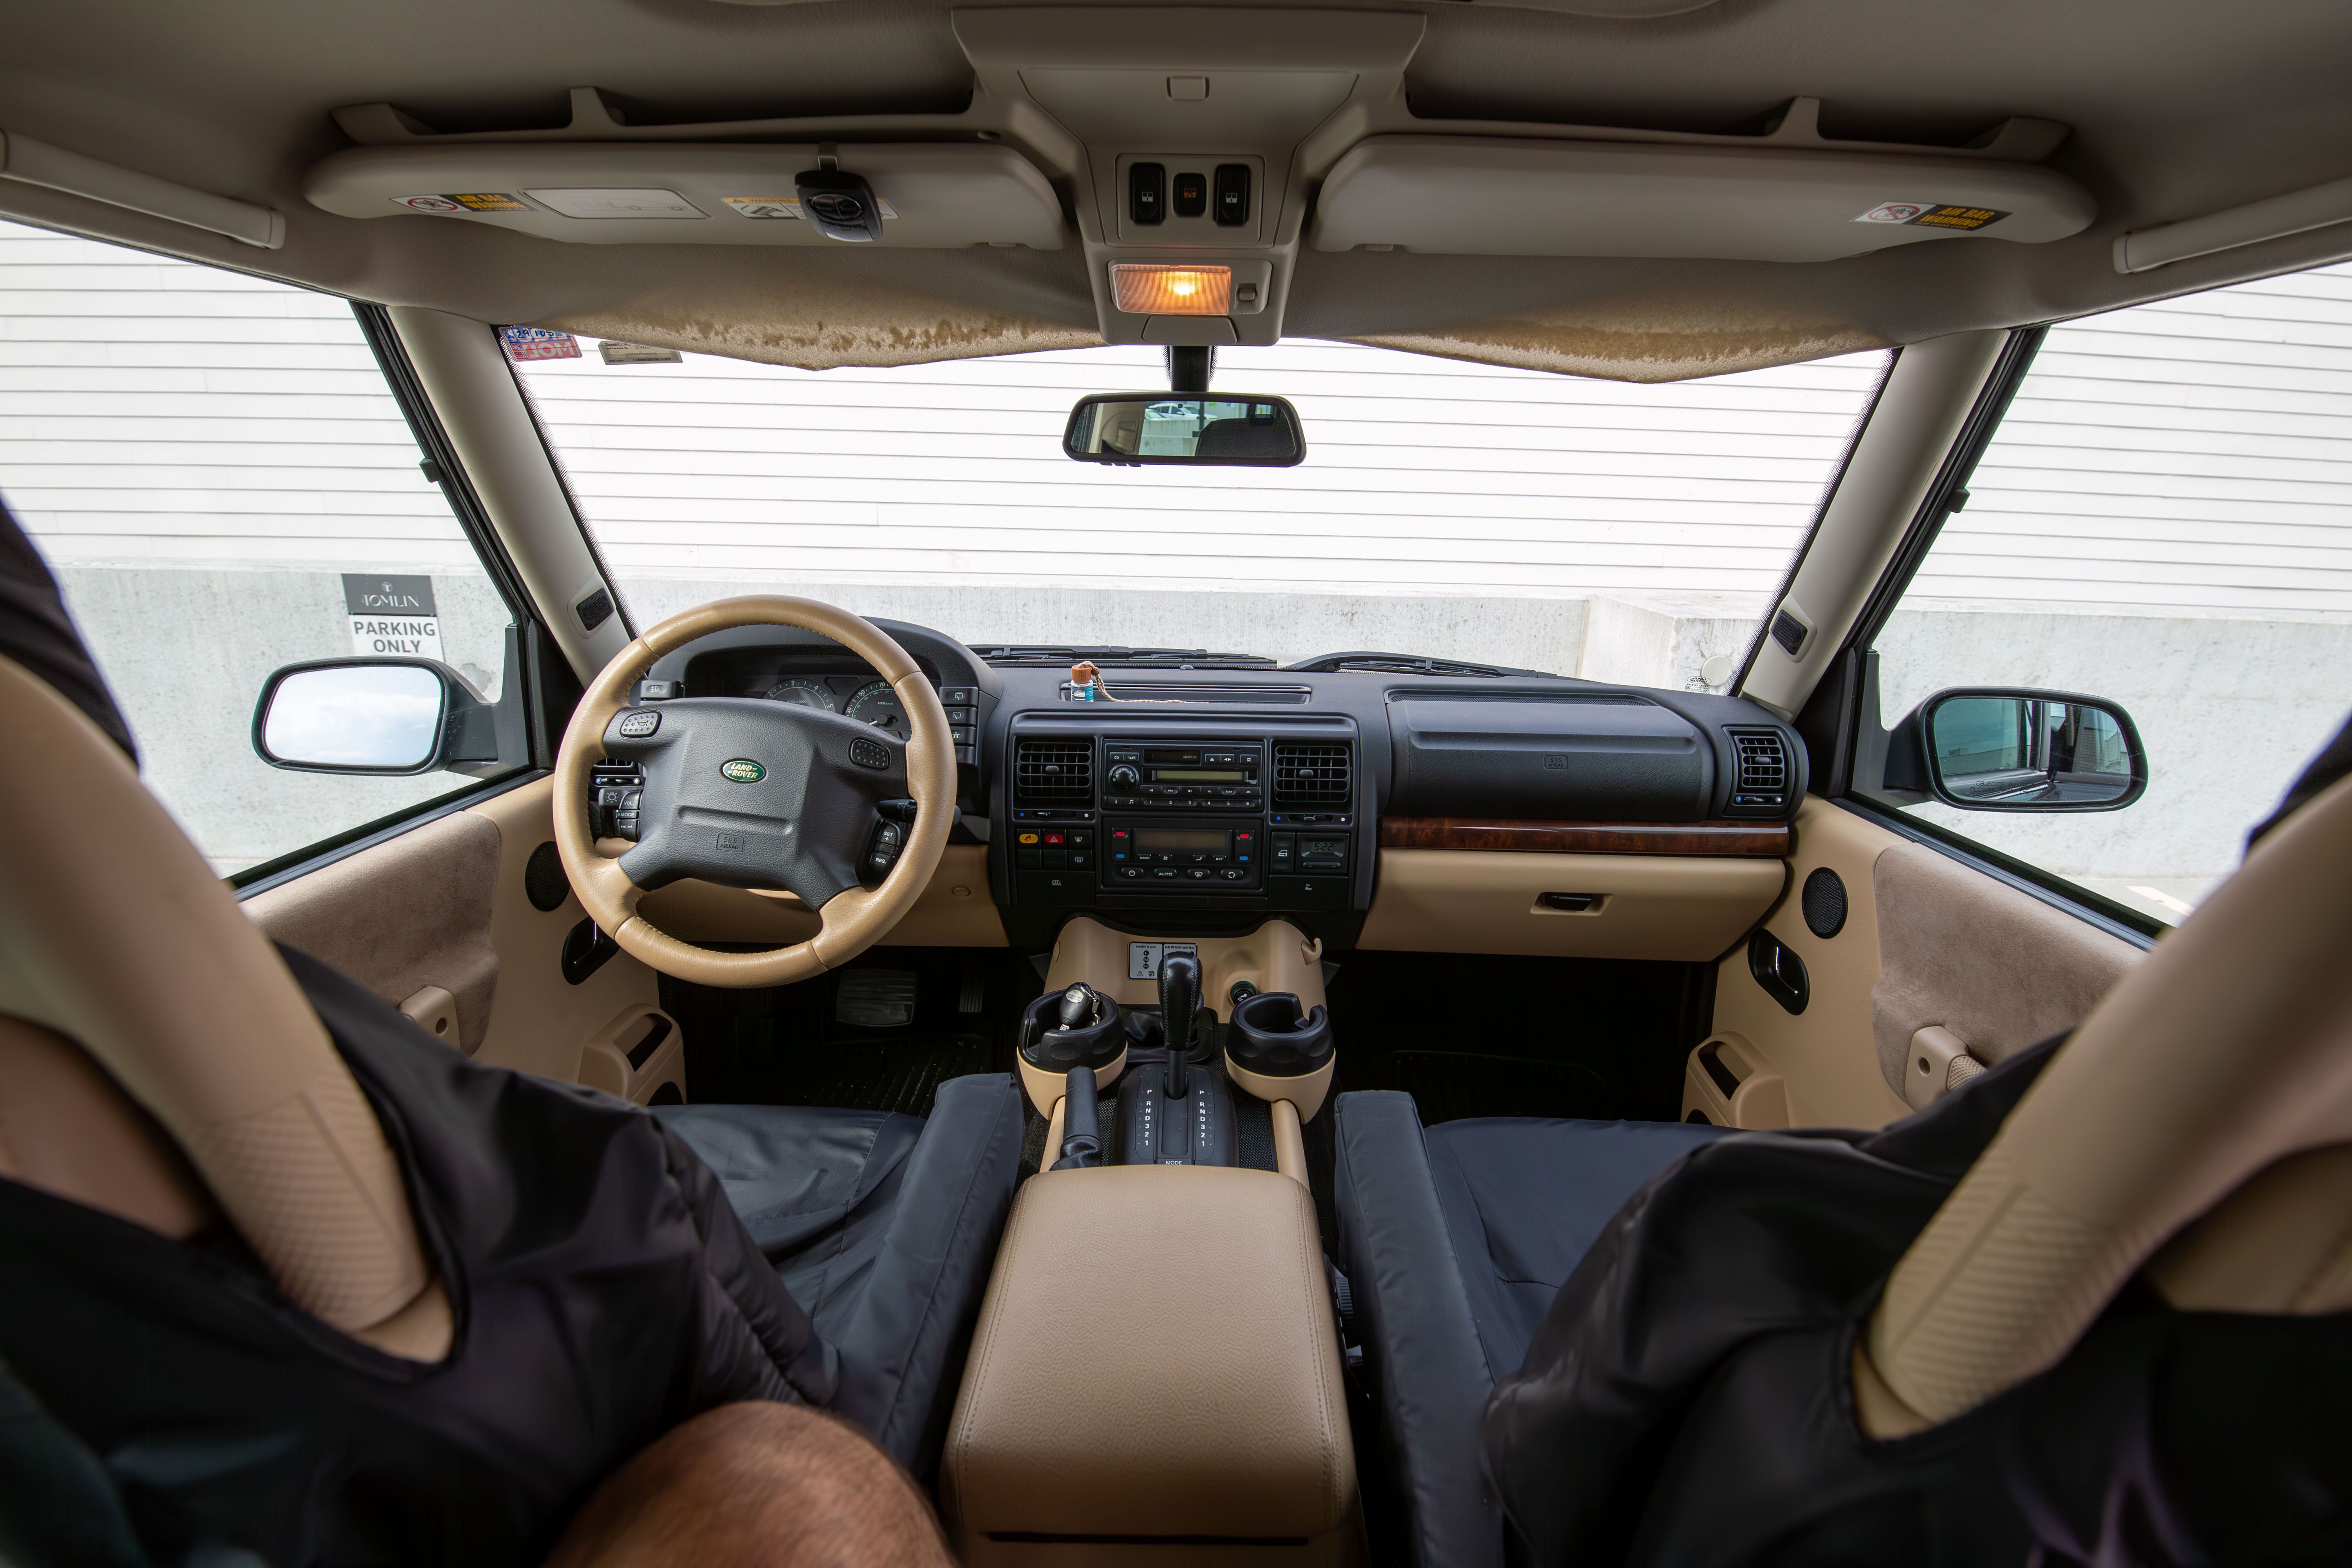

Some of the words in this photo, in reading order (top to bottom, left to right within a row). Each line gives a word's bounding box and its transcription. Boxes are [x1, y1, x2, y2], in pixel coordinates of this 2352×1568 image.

[1937, 207, 1967, 216] AIR
[1962, 209, 1995, 219] BAG
[1919, 214, 1984, 227] WARNING
[361, 594, 419, 607] TOMLIN
[354, 621, 436, 636] PARKING
[373, 639, 421, 653] ONLY
[731, 763, 753, 771] LAND
[731, 770, 758, 779] ROVER
[1314, 842, 1334, 851] 5:22
